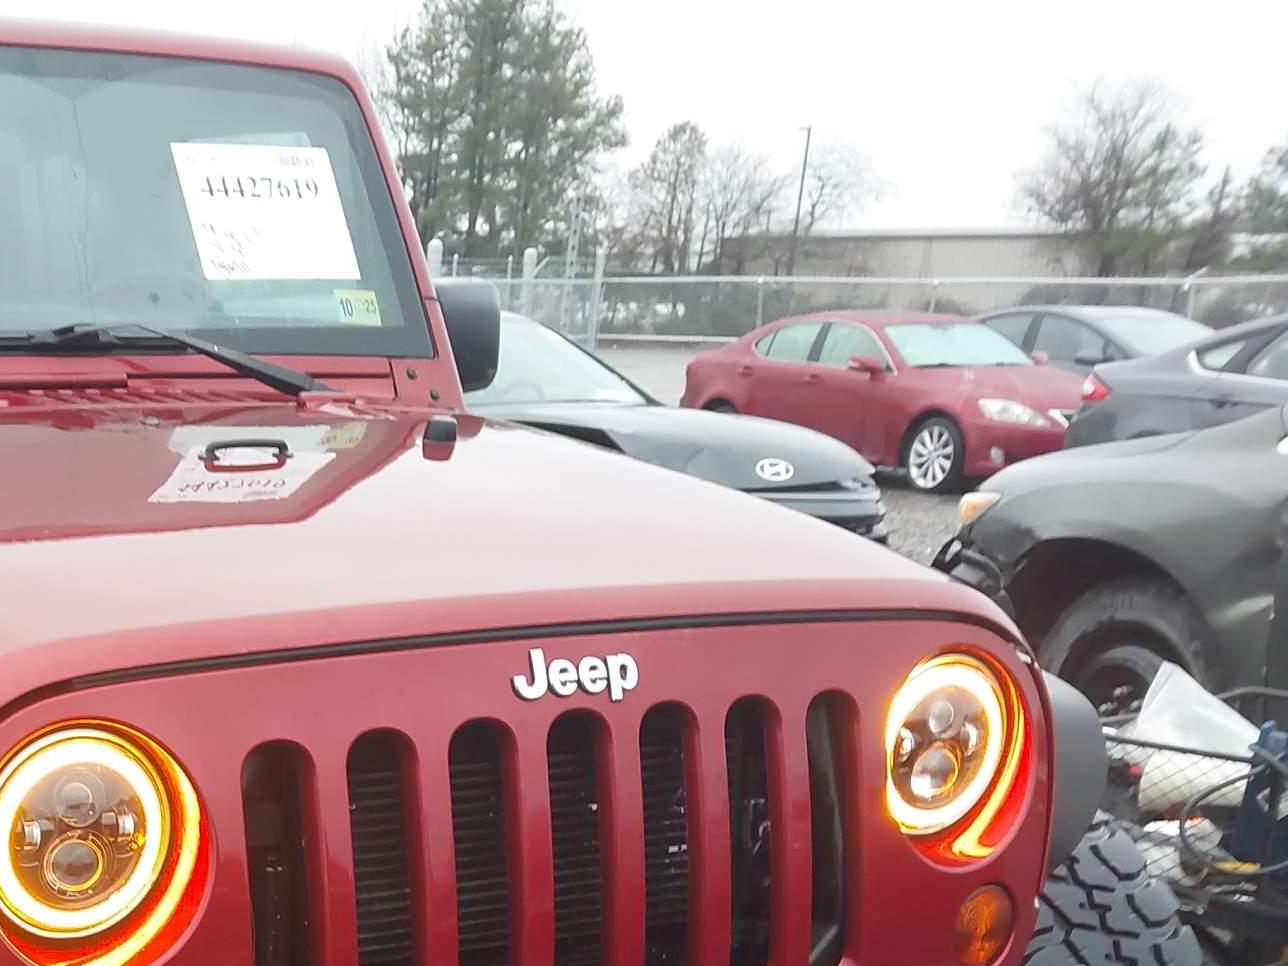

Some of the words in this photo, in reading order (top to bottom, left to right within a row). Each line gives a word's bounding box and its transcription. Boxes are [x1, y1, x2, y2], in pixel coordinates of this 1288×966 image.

[200, 175, 319, 199] 44427619
[339, 297, 354, 317] 10
[511, 647, 640, 703] Jeep
